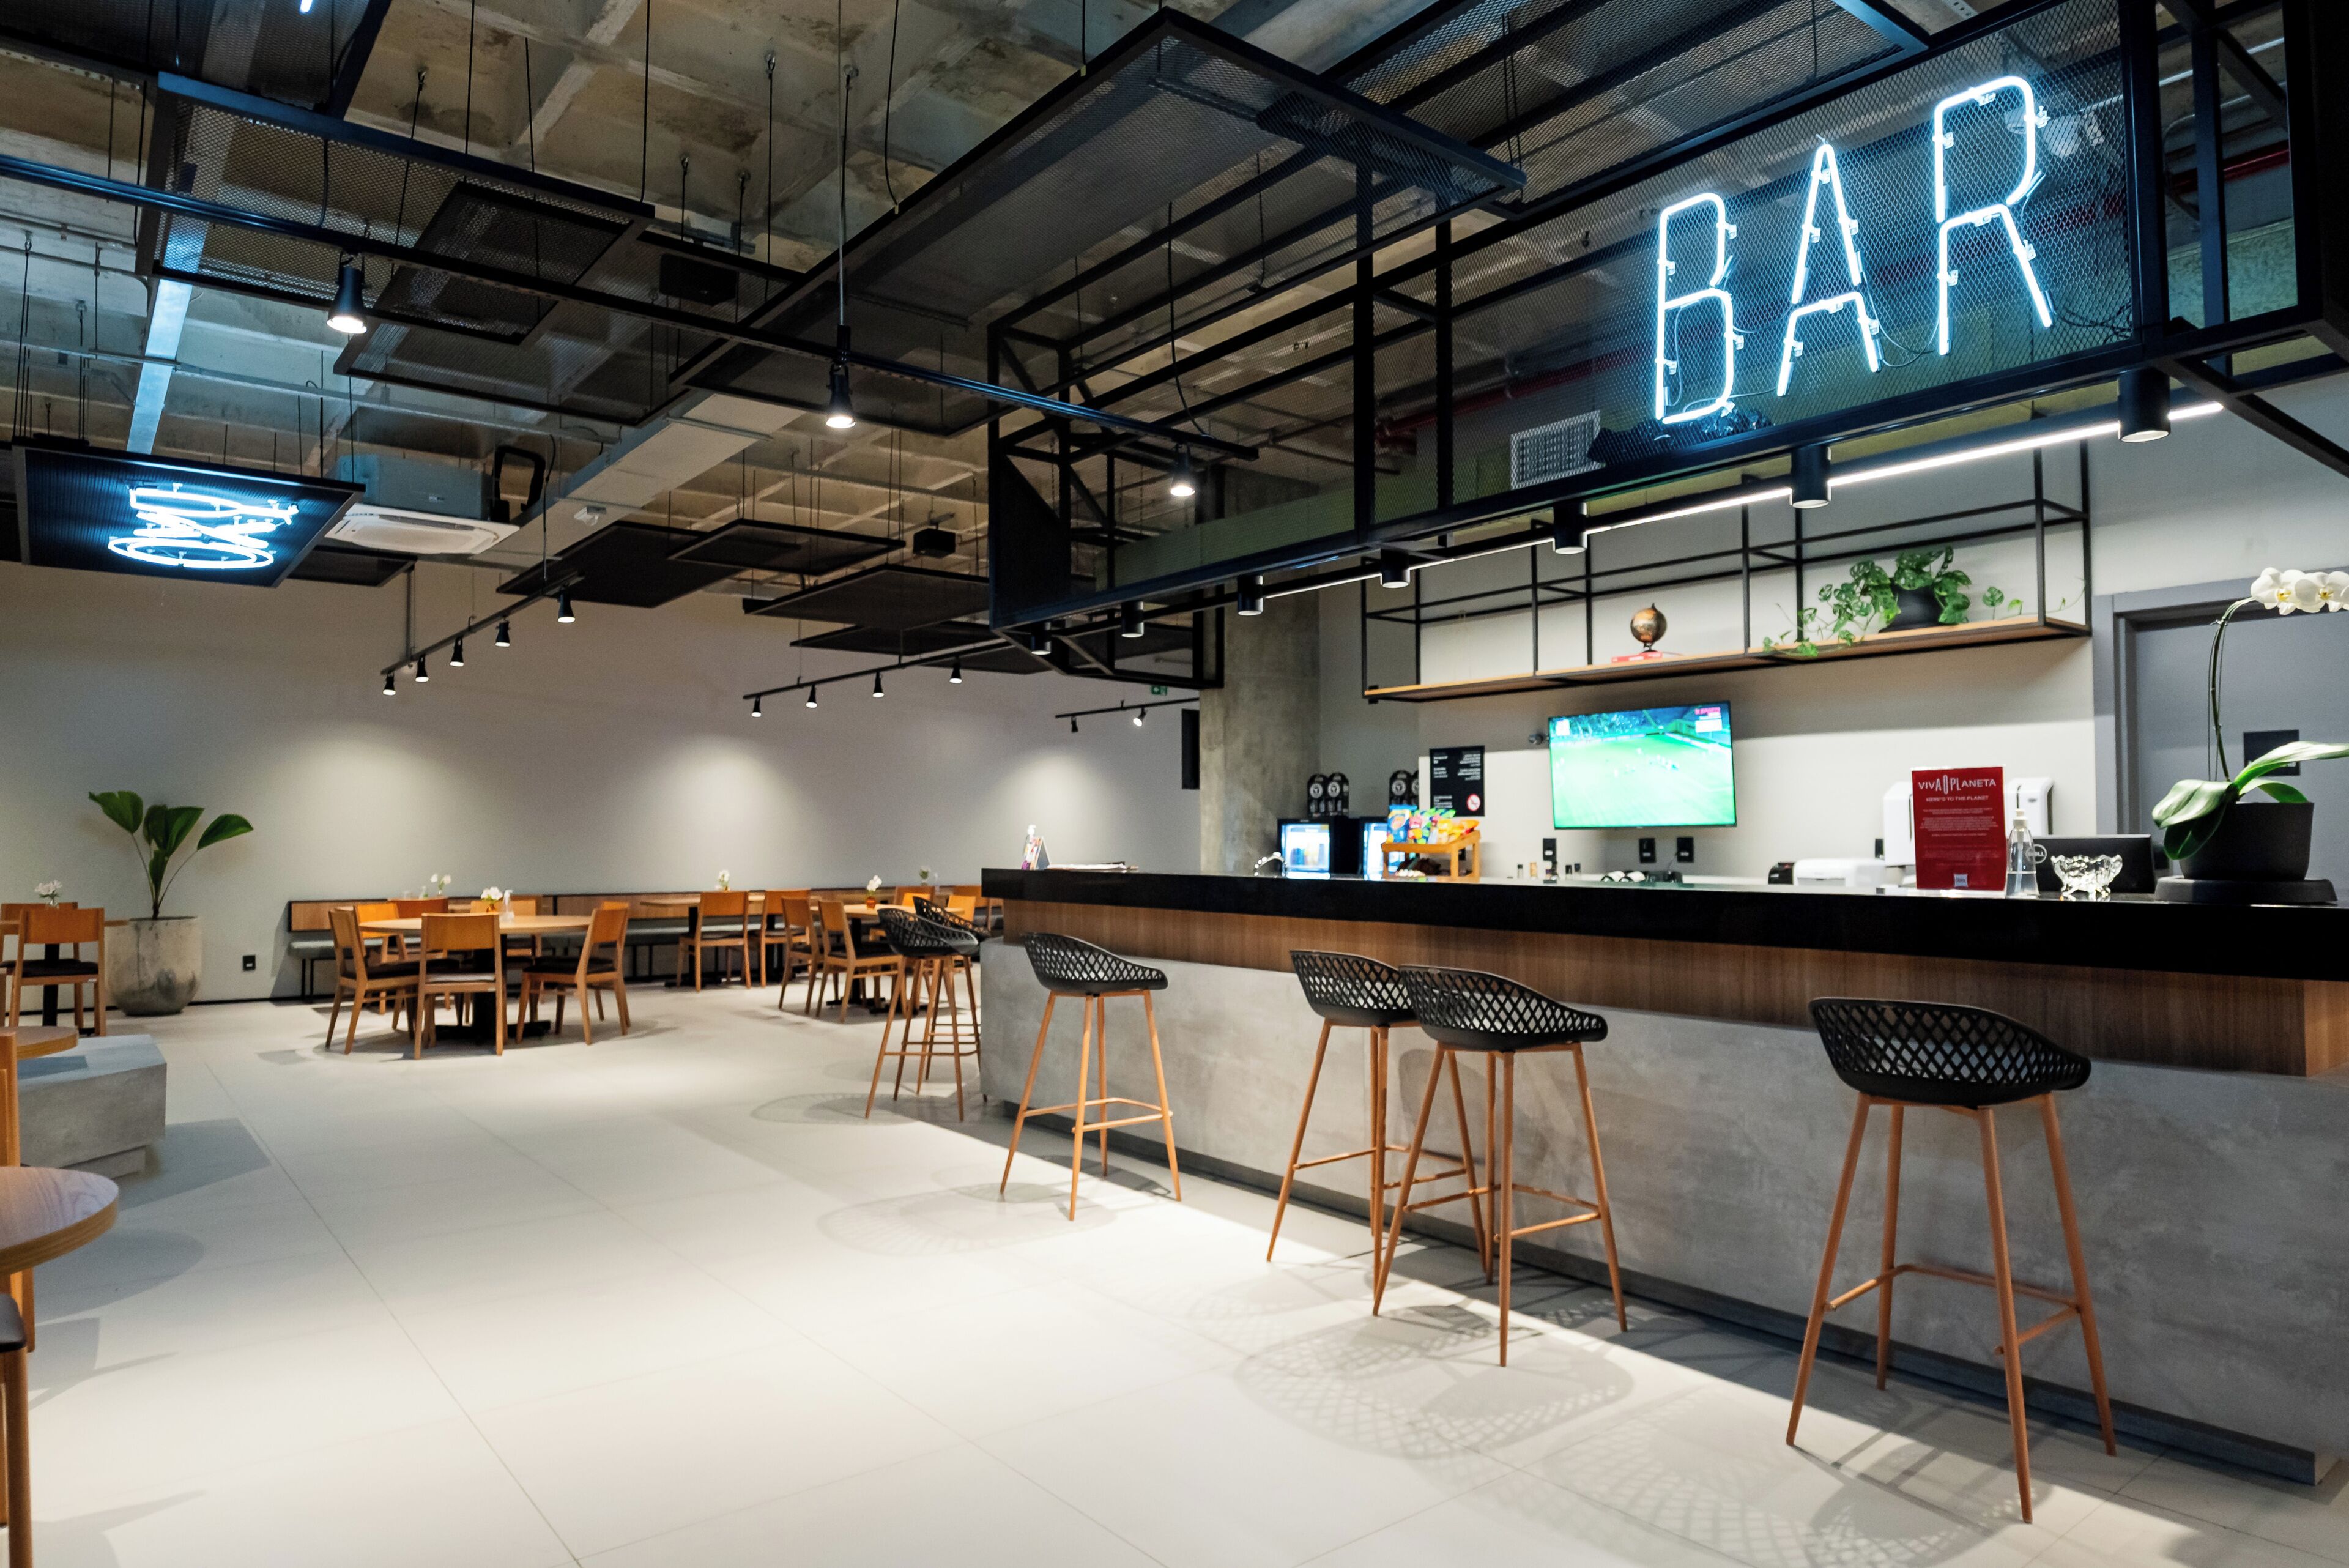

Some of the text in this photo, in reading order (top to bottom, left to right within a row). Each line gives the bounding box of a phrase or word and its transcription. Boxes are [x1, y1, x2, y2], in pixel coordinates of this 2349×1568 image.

[1655, 75, 2053, 425] BAR
[1918, 778, 1942, 792] VIVA
[1950, 777, 1997, 792] PLANETA
